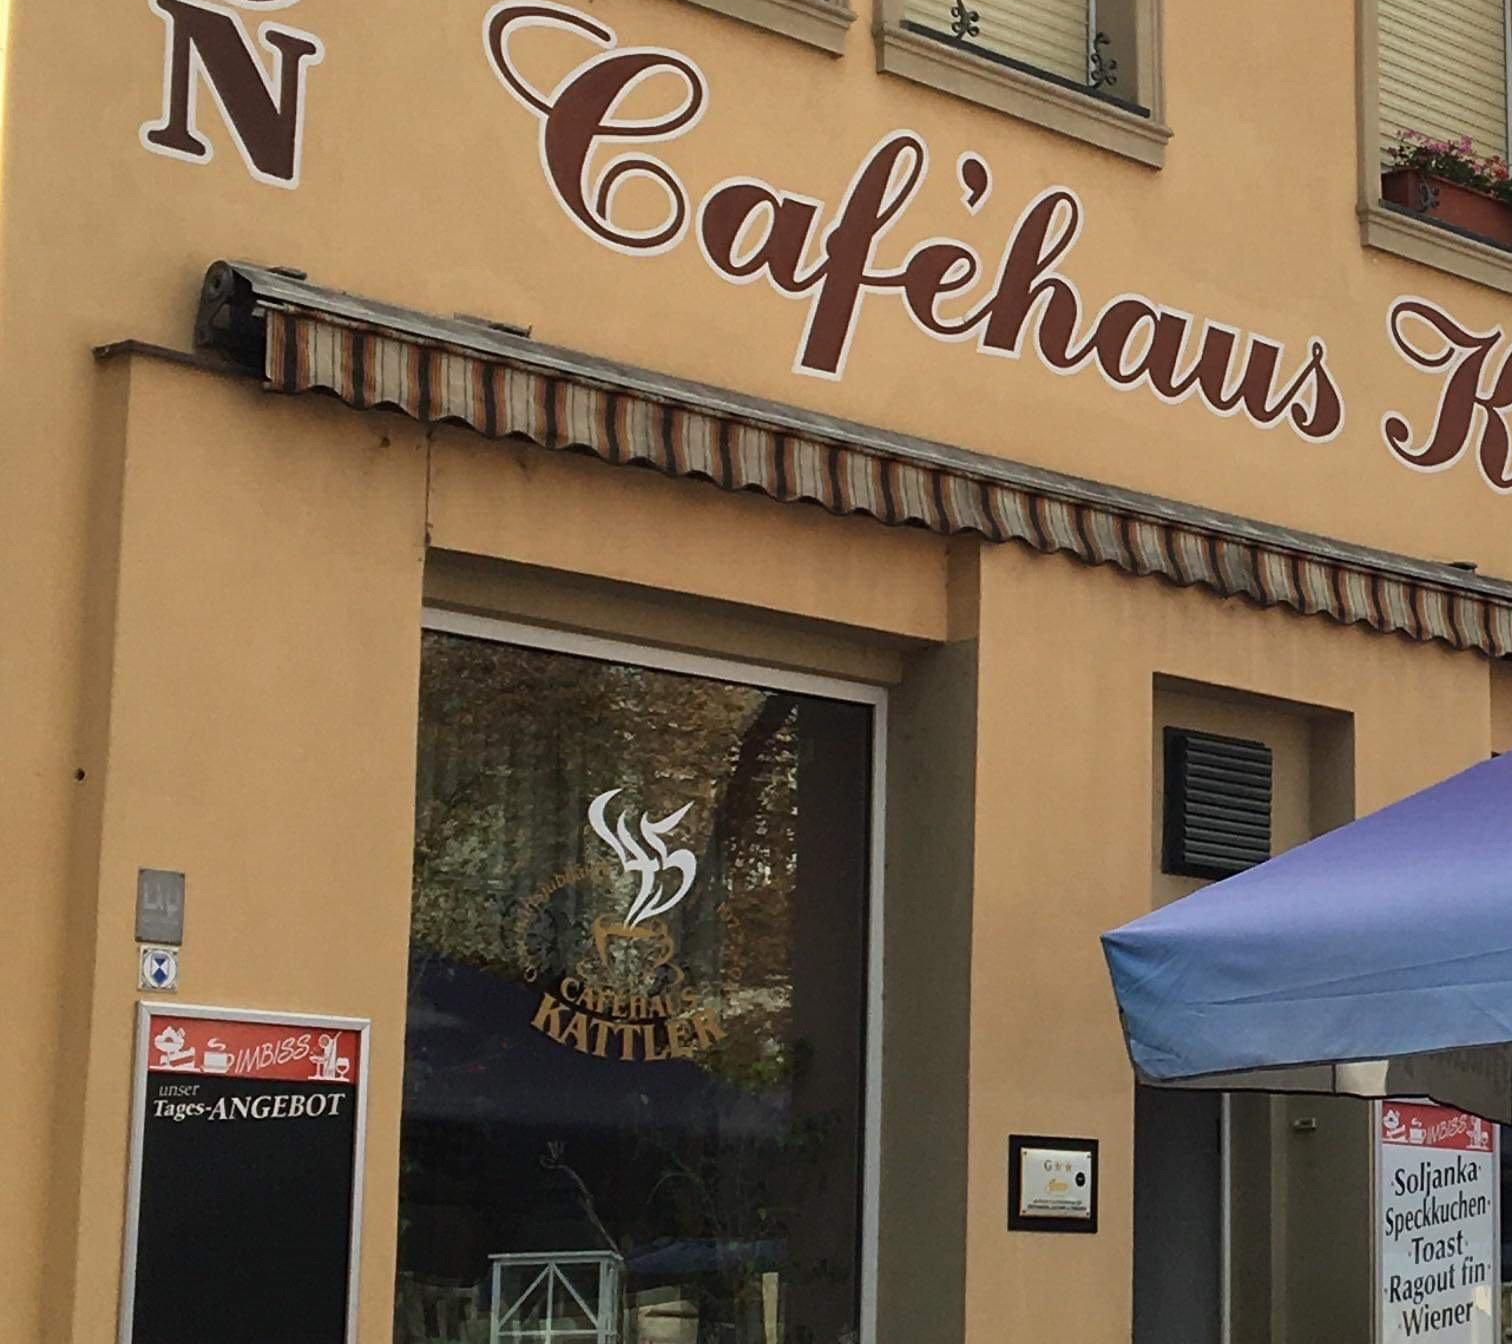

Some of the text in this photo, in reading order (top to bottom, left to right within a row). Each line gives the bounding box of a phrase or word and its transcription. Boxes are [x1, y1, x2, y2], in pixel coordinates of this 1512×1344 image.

[530, 992, 728, 1061] KATTLER
[234, 1033, 312, 1074] IMBISS
[153, 1093, 346, 1122] Tages-ANGEBOT
[158, 1084, 200, 1097] unser
[1394, 1155, 1478, 1197] Soljanka
[1385, 1190, 1486, 1241] Speckkuchen
[1411, 1230, 1463, 1264] Toast
[1389, 1256, 1486, 1305] Ragout fin
[1402, 1304, 1474, 1337] Wiener
